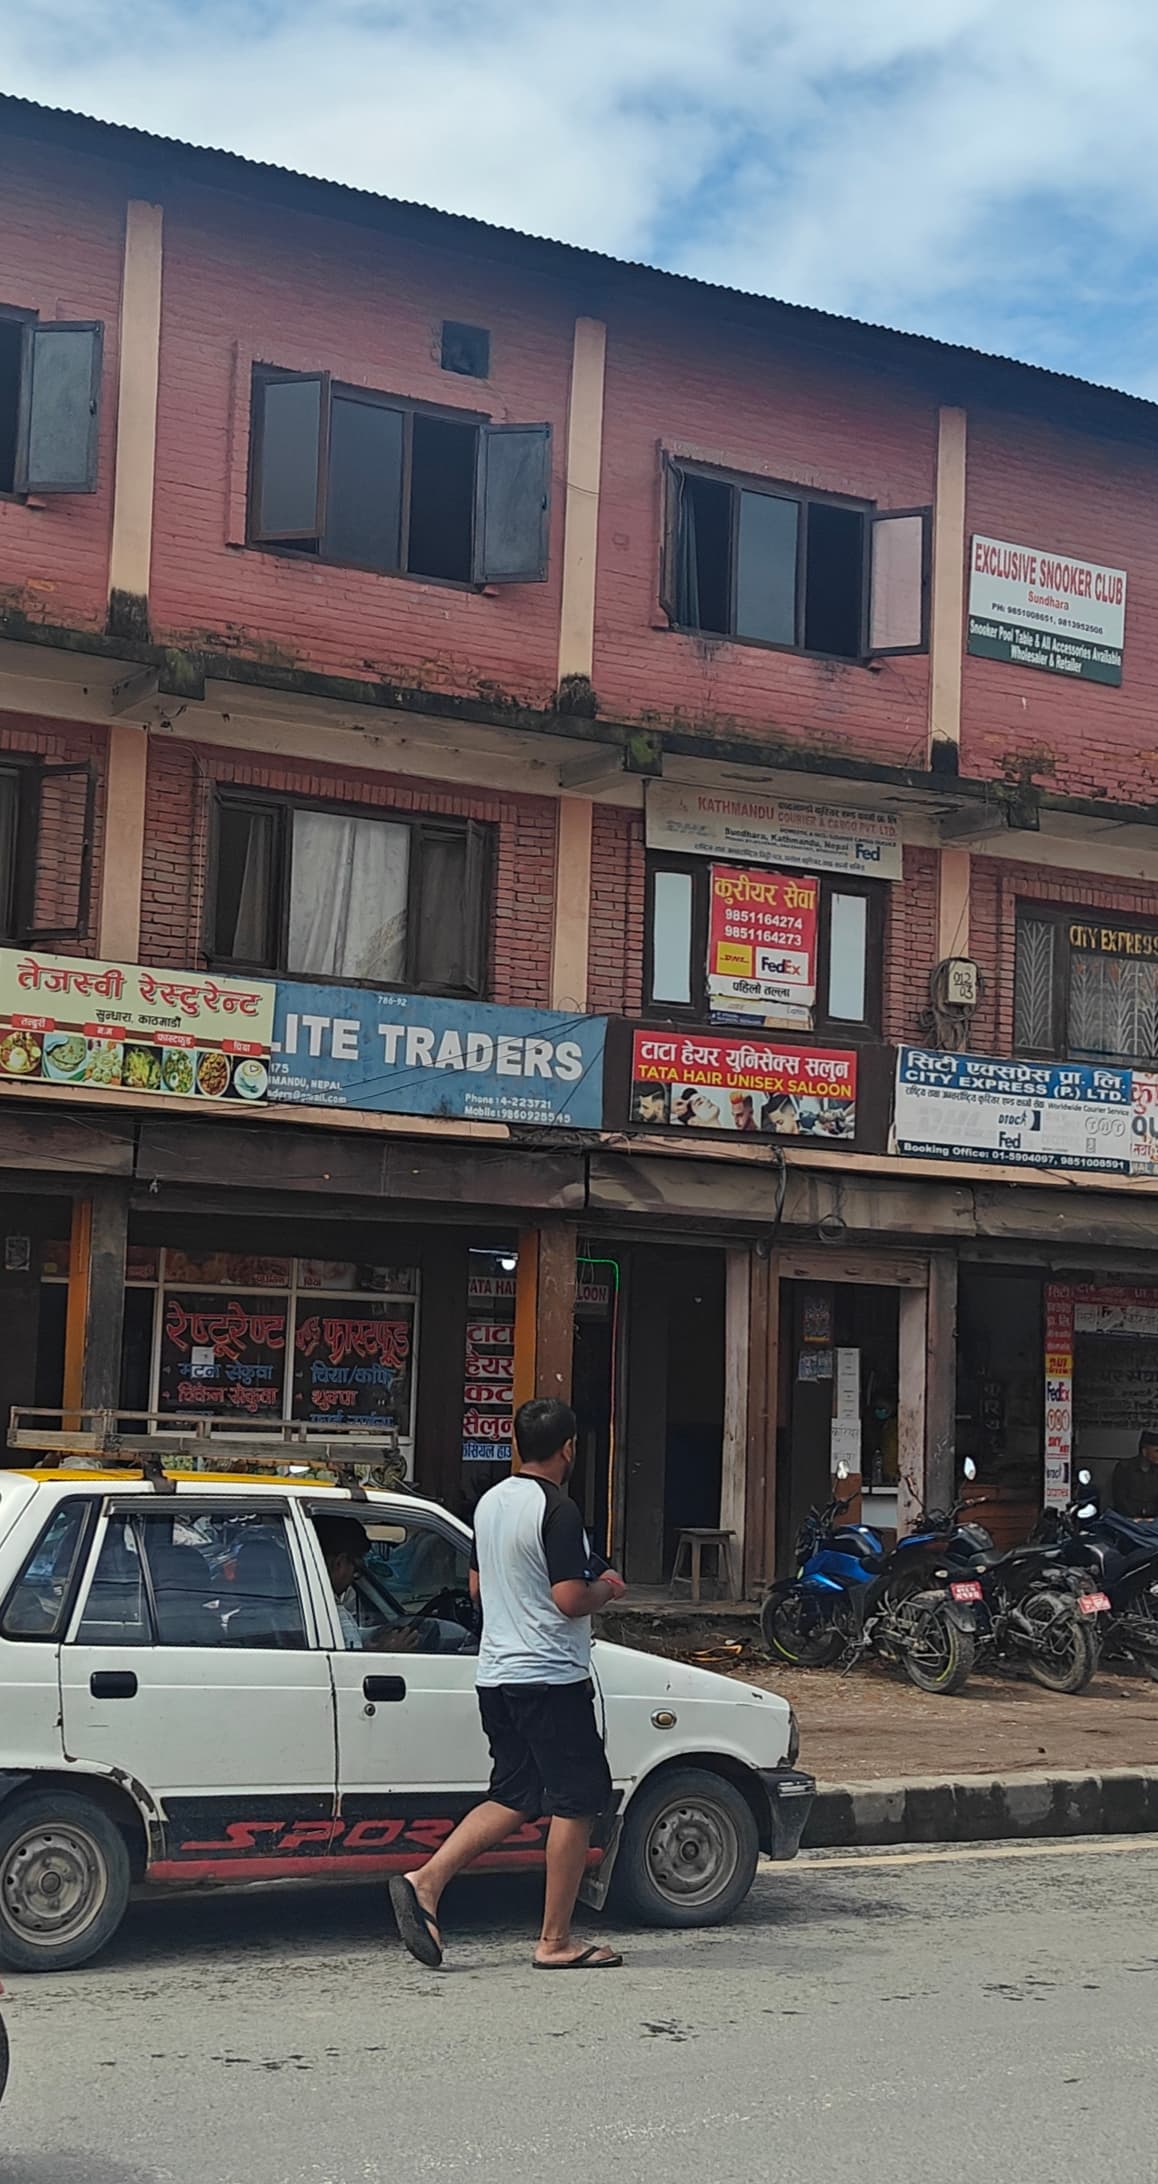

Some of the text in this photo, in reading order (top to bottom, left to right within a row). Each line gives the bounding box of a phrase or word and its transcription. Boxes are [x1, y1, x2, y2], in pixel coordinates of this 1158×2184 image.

[975, 543, 1123, 605] EXCLUSIVE SNOOKER CLUB
[1028, 591, 1069, 611] Sundhara
[970, 620, 998, 638] Snooker
[999, 624, 1014, 642] Pool
[1015, 629, 1033, 646] Table
[1041, 635, 1051, 650] All
[1052, 637, 1091, 659] Accessories
[1092, 646, 1122, 666] Available
[1011, 644, 1048, 666] Wholesaler
[1055, 654, 1082, 673] Retailer
[697, 797, 774, 820] KATHMANDU
[771, 834, 821, 848] Kathmandu,
[824, 841, 849, 852] Nepal
[855, 843, 881, 861] Fed
[714, 874, 816, 910] कुरीयर सेवा
[725, 908, 802, 930] 9851164274
[725, 925, 802, 946] 9851164273
[1070, 925, 1098, 949] CITY
[761, 956, 801, 976] FedEx
[17, 958, 263, 1016] तेजस्वी रेस्टुरेन्ट
[732, 980, 790, 998] पहिलो तल्ला
[271, 1013, 584, 1082] ITE TRADERS
[641, 1039, 851, 1082] टाटा हेयर युनिसेक्स सलुन
[907, 1050, 1126, 1091] सिटी एक्सप्रेस प्रा. लि.
[311, 1079, 343, 1091] NEPAL
[638, 1063, 852, 1099] TATA HAIR UNISEX SALOON
[905, 1069, 952, 1086] CITY
[958, 1076, 1047, 1096] EXPRESS
[1087, 1088, 1127, 1103] LTD.
[1048, 1102, 1082, 1111] Worldwide
[1083, 1105, 1106, 1114] Courier
[1107, 1107, 1129, 1116] Service
[903, 1142, 949, 1156] Booking
[952, 1146, 990, 1159] Office:
[998, 1131, 1022, 1149] Fed
[469, 1279, 491, 1294] ATA
[181, 1818, 552, 1851] SPORS
